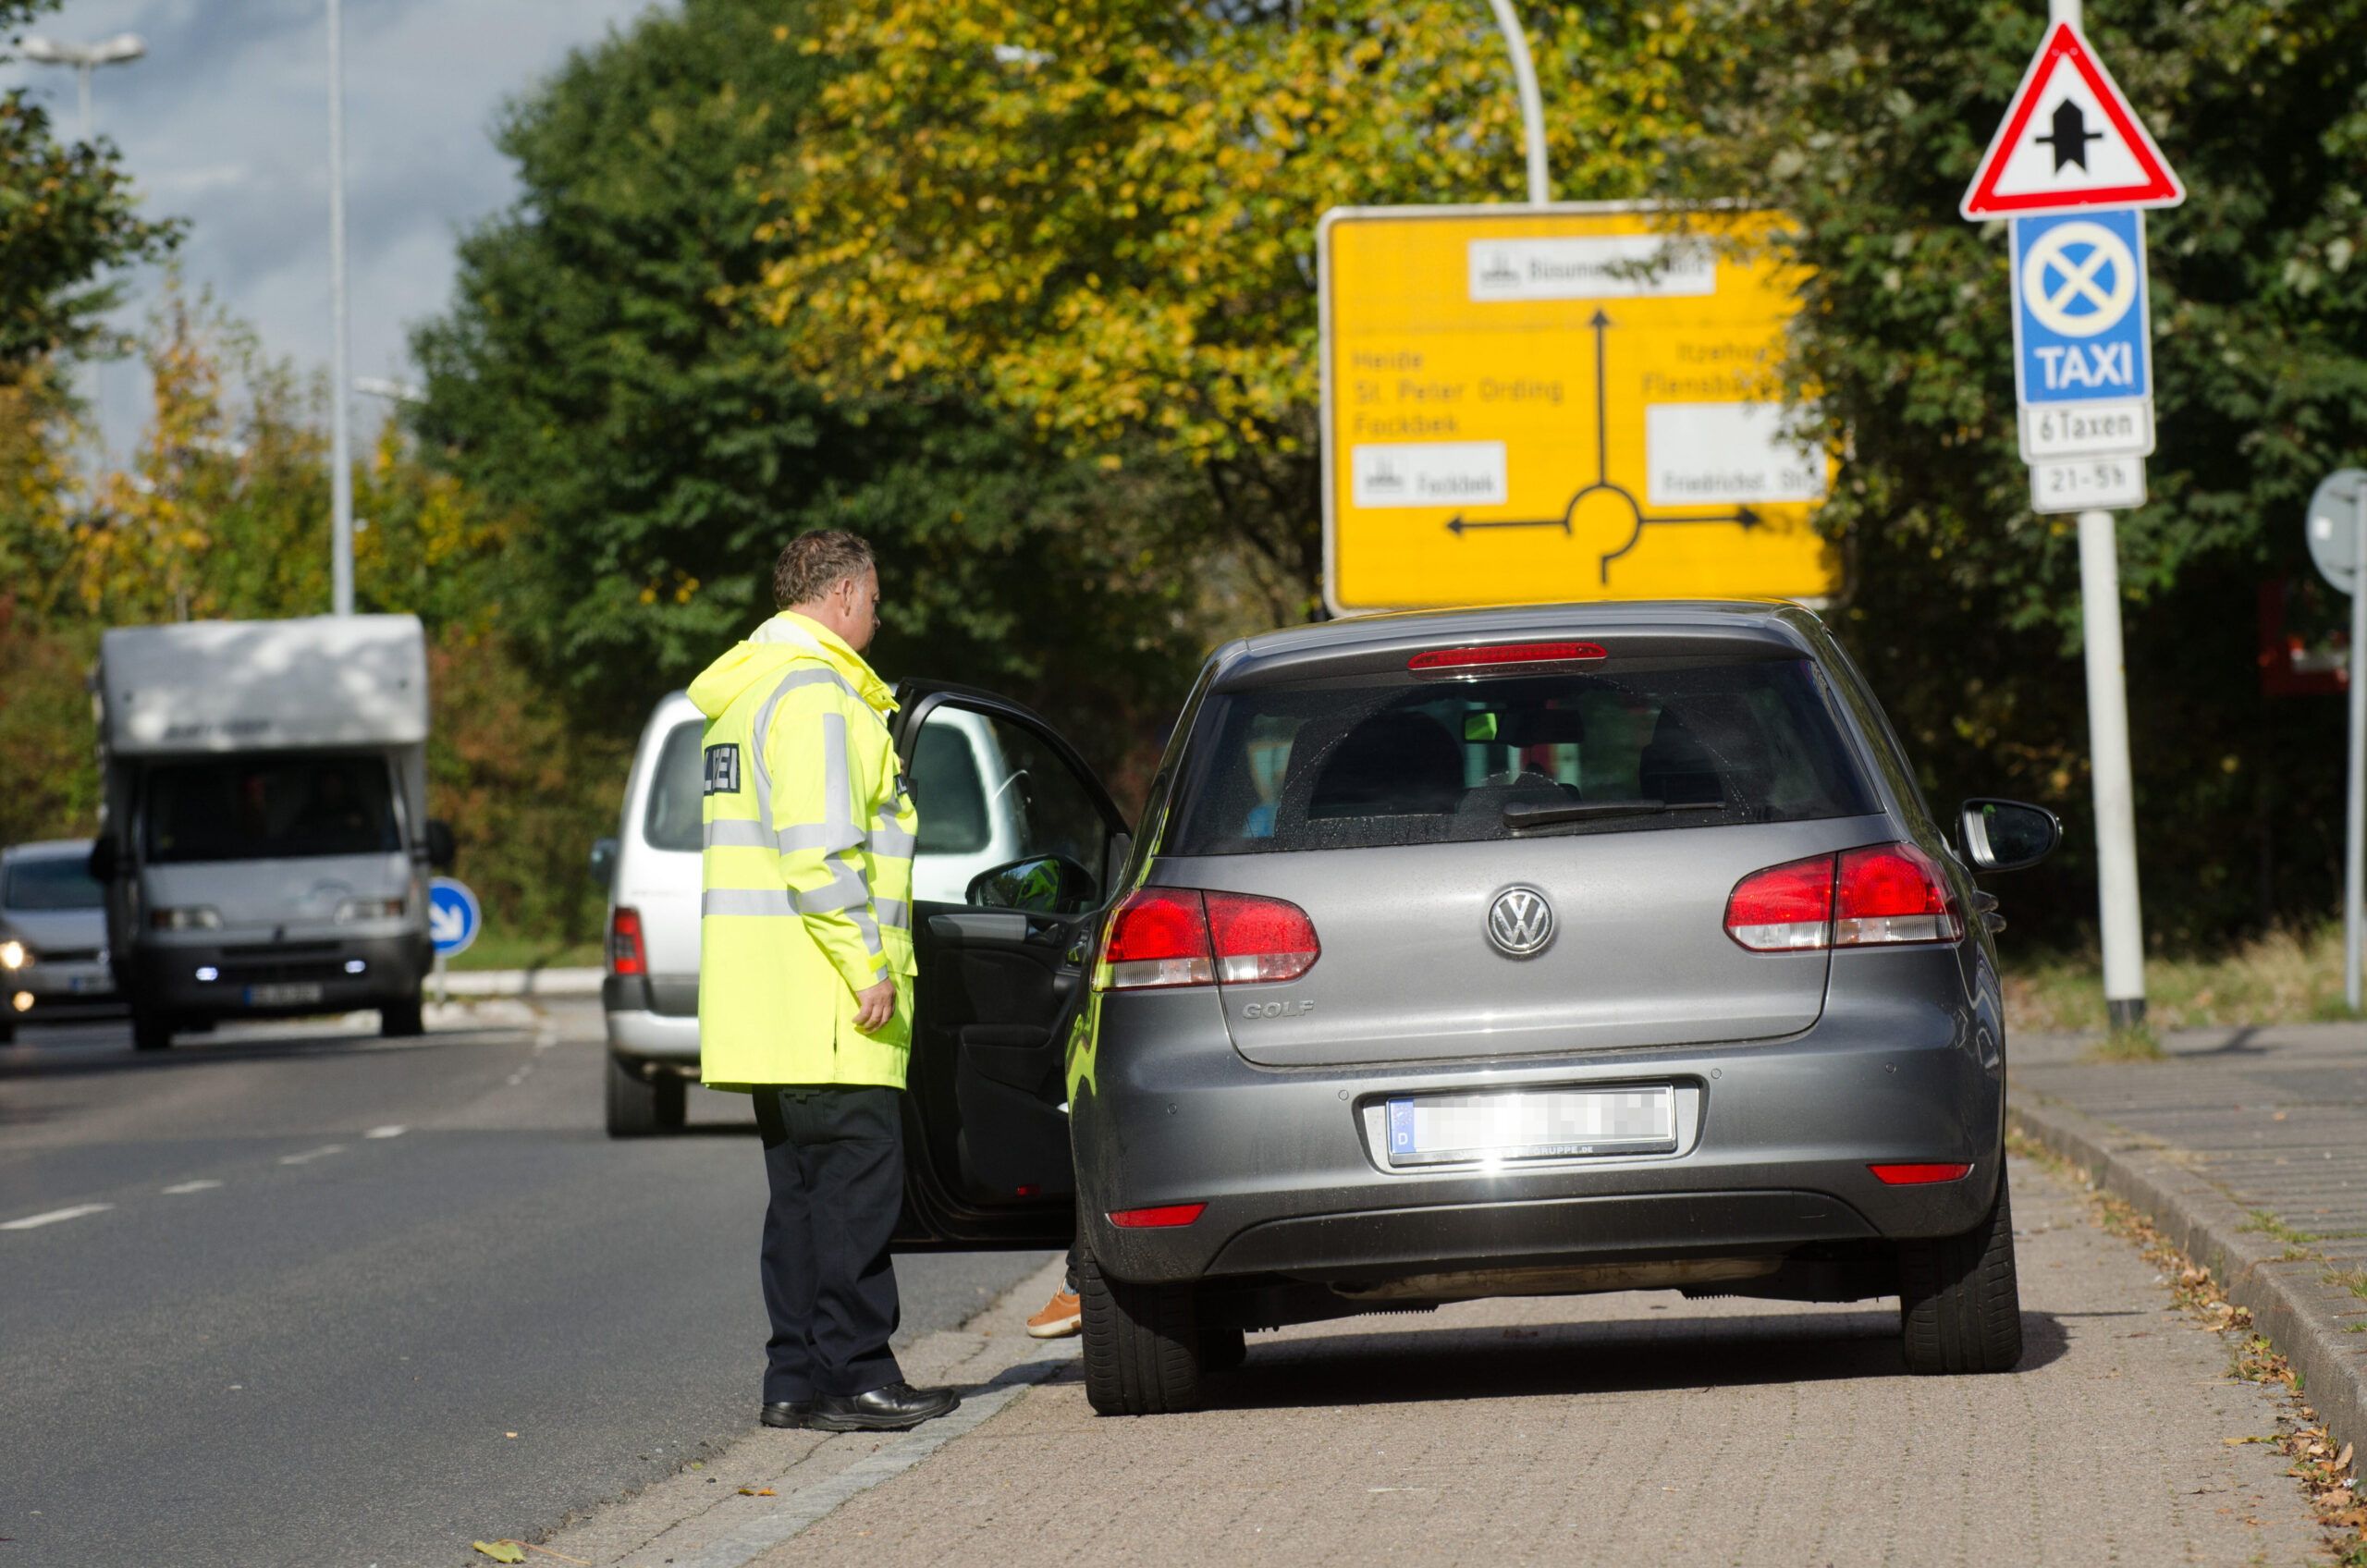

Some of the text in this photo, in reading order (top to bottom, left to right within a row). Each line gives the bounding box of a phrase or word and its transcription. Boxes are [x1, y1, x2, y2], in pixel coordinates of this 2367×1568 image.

[1352, 350, 1424, 372] Heide
[2034, 342, 2134, 389] TAXI
[1398, 378, 1464, 401] Peter
[1480, 375, 1564, 407] Ording
[1354, 411, 1460, 435] Fockbek
[1242, 999, 1314, 1019] GOLF
[1398, 1133, 1408, 1145] D
